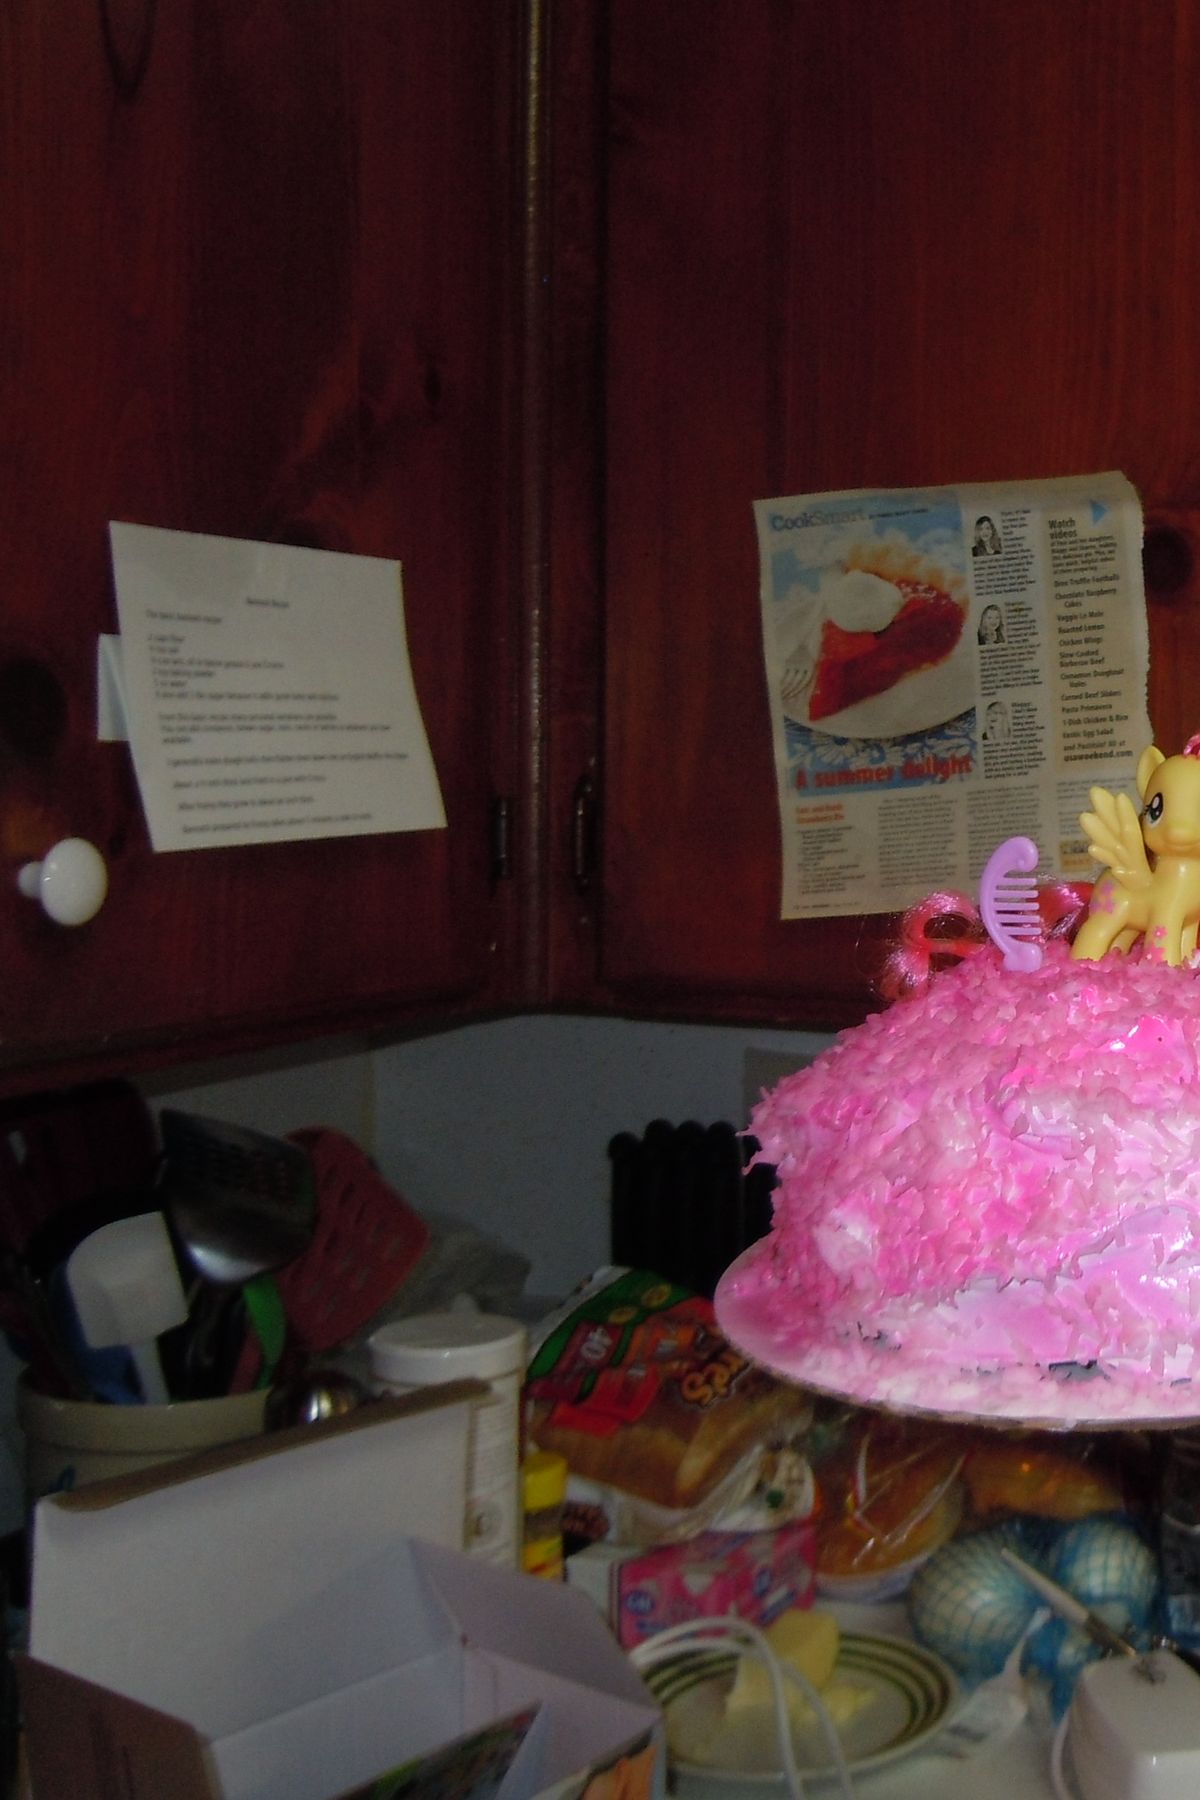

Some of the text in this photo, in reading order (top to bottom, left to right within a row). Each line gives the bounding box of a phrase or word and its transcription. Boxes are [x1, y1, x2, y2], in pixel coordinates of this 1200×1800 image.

[1048, 517, 1076, 529] Watch
[1049, 529, 1078, 539] videos
[796, 768, 807, 790] A
[814, 766, 894, 789] summer
[900, 753, 974, 781] delight
